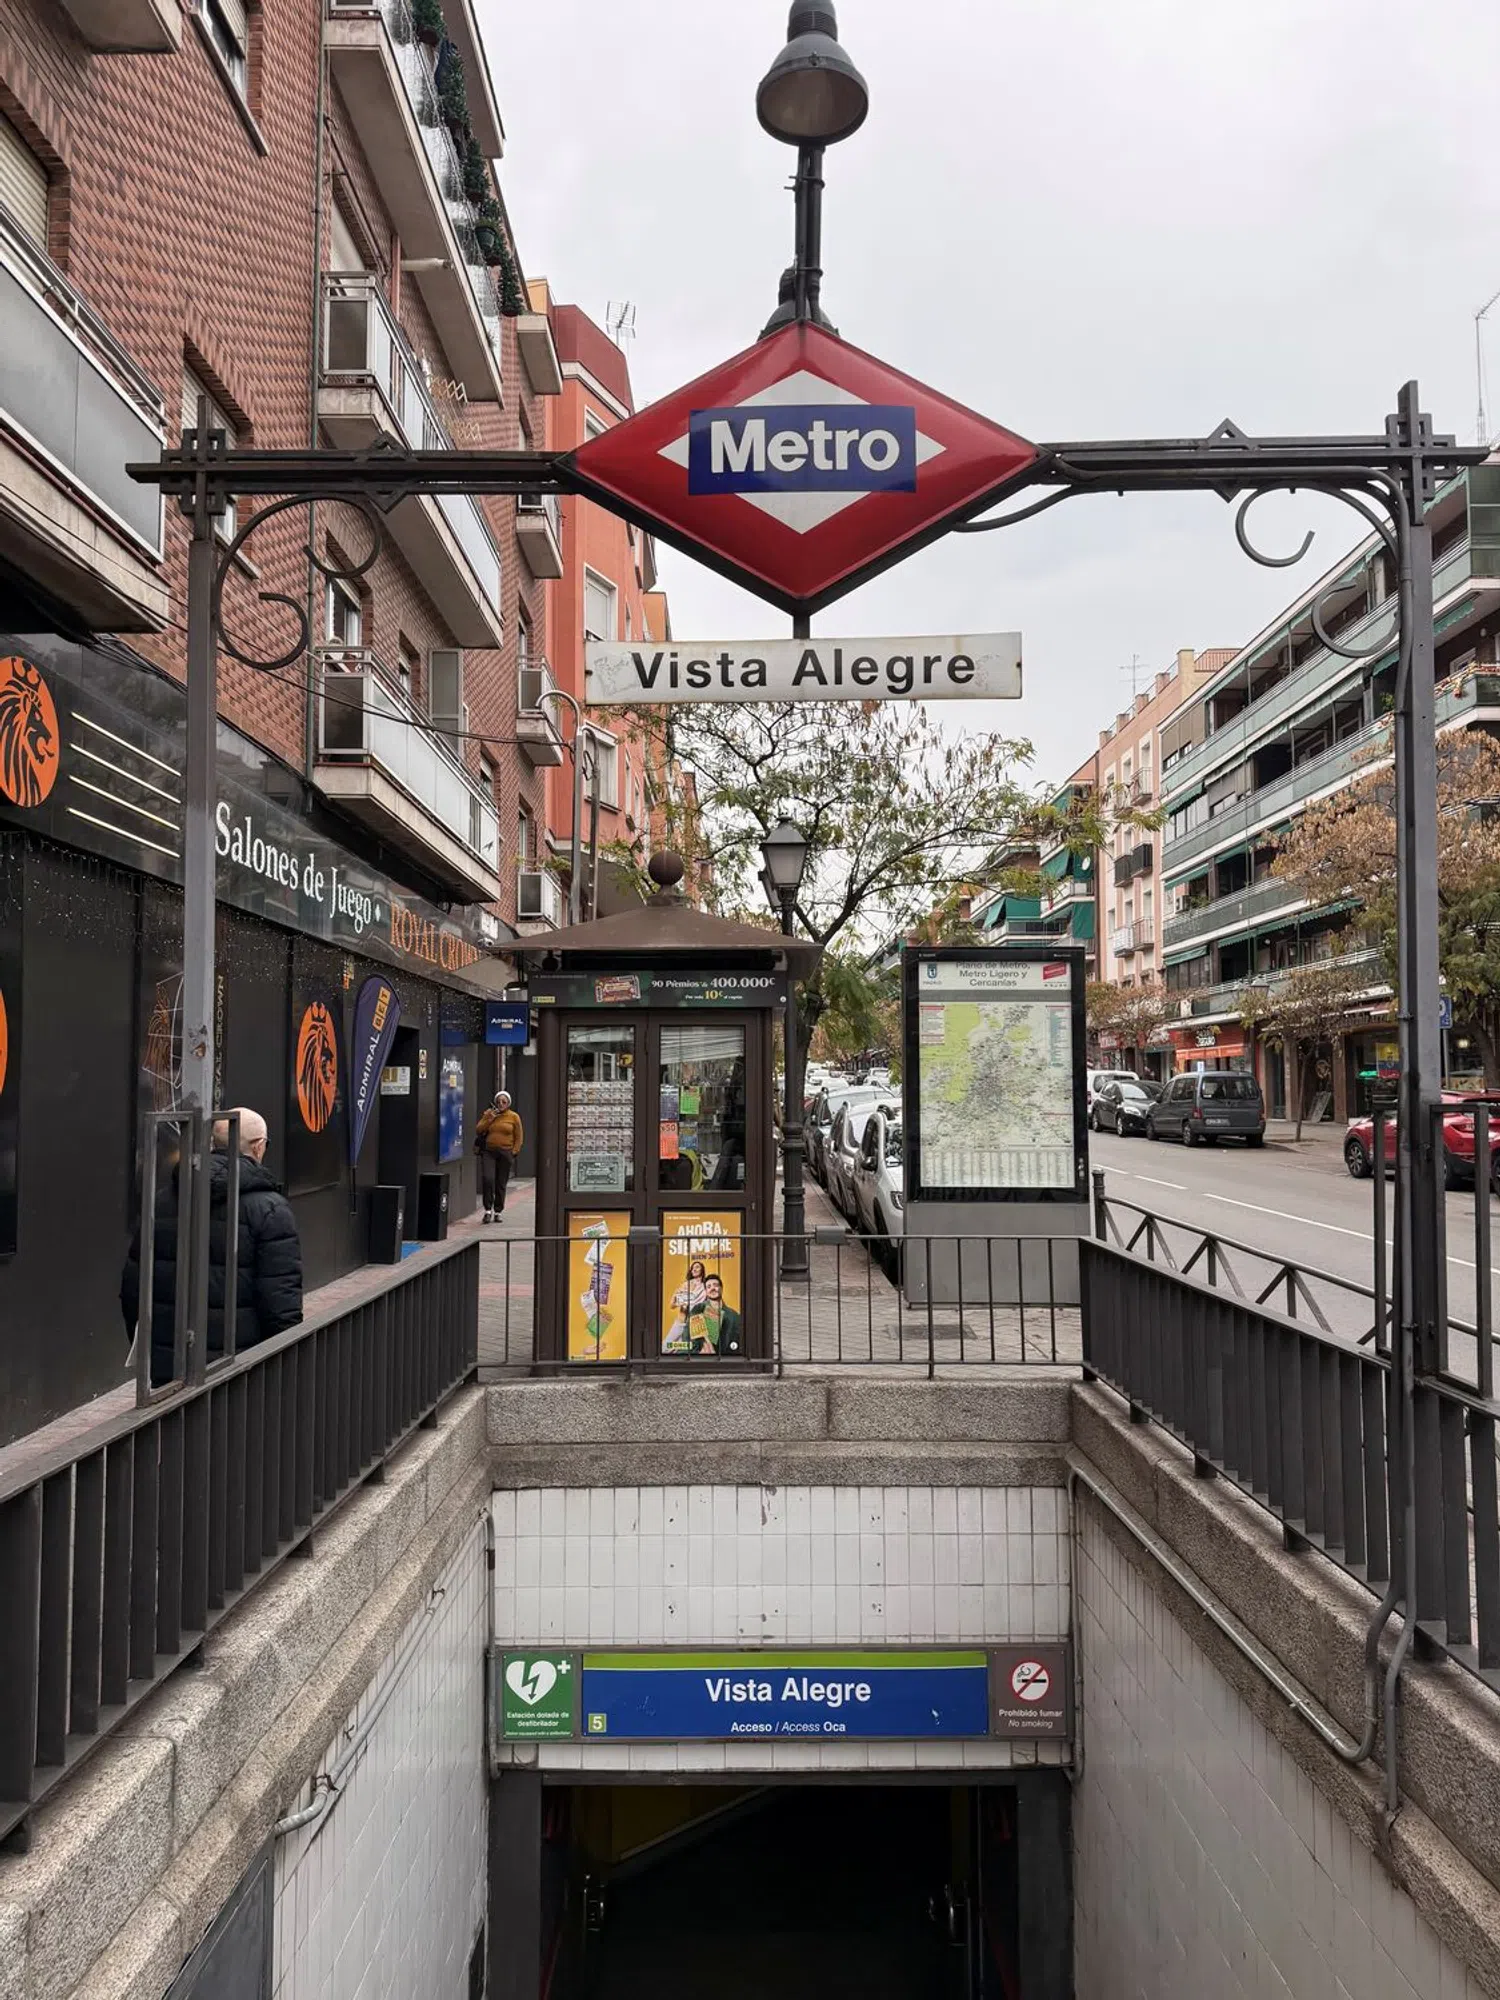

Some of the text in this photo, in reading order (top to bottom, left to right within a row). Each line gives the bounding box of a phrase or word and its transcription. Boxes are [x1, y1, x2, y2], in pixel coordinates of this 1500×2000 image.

[710, 418, 900, 473] Metro
[632, 648, 975, 693] Vista Alegre
[215, 802, 299, 889] Salones
[303, 853, 324, 902] de
[330, 867, 372, 934] Juego
[390, 901, 437, 963] ROYAL
[989, 969, 1020, 979] Ligero
[1021, 971, 1028, 979] y
[651, 980, 664, 988] 90
[969, 978, 1017, 987] Cercanías
[357, 987, 391, 1112] ADMIRAL BET
[677, 1221, 721, 1236] AHORA
[668, 1238, 732, 1256] SIEMPRE
[705, 1677, 872, 1707] Vista Alegre
[506, 1711, 569, 1719] Estación dotada de
[998, 1708, 1063, 1717] Prohibido fumar
[593, 1715, 603, 1730] 5
[731, 1721, 772, 1732] Acceso
[781, 1721, 820, 1732] Access
[823, 1721, 846, 1732] Oca
[1021, 1719, 1054, 1729] smoking
